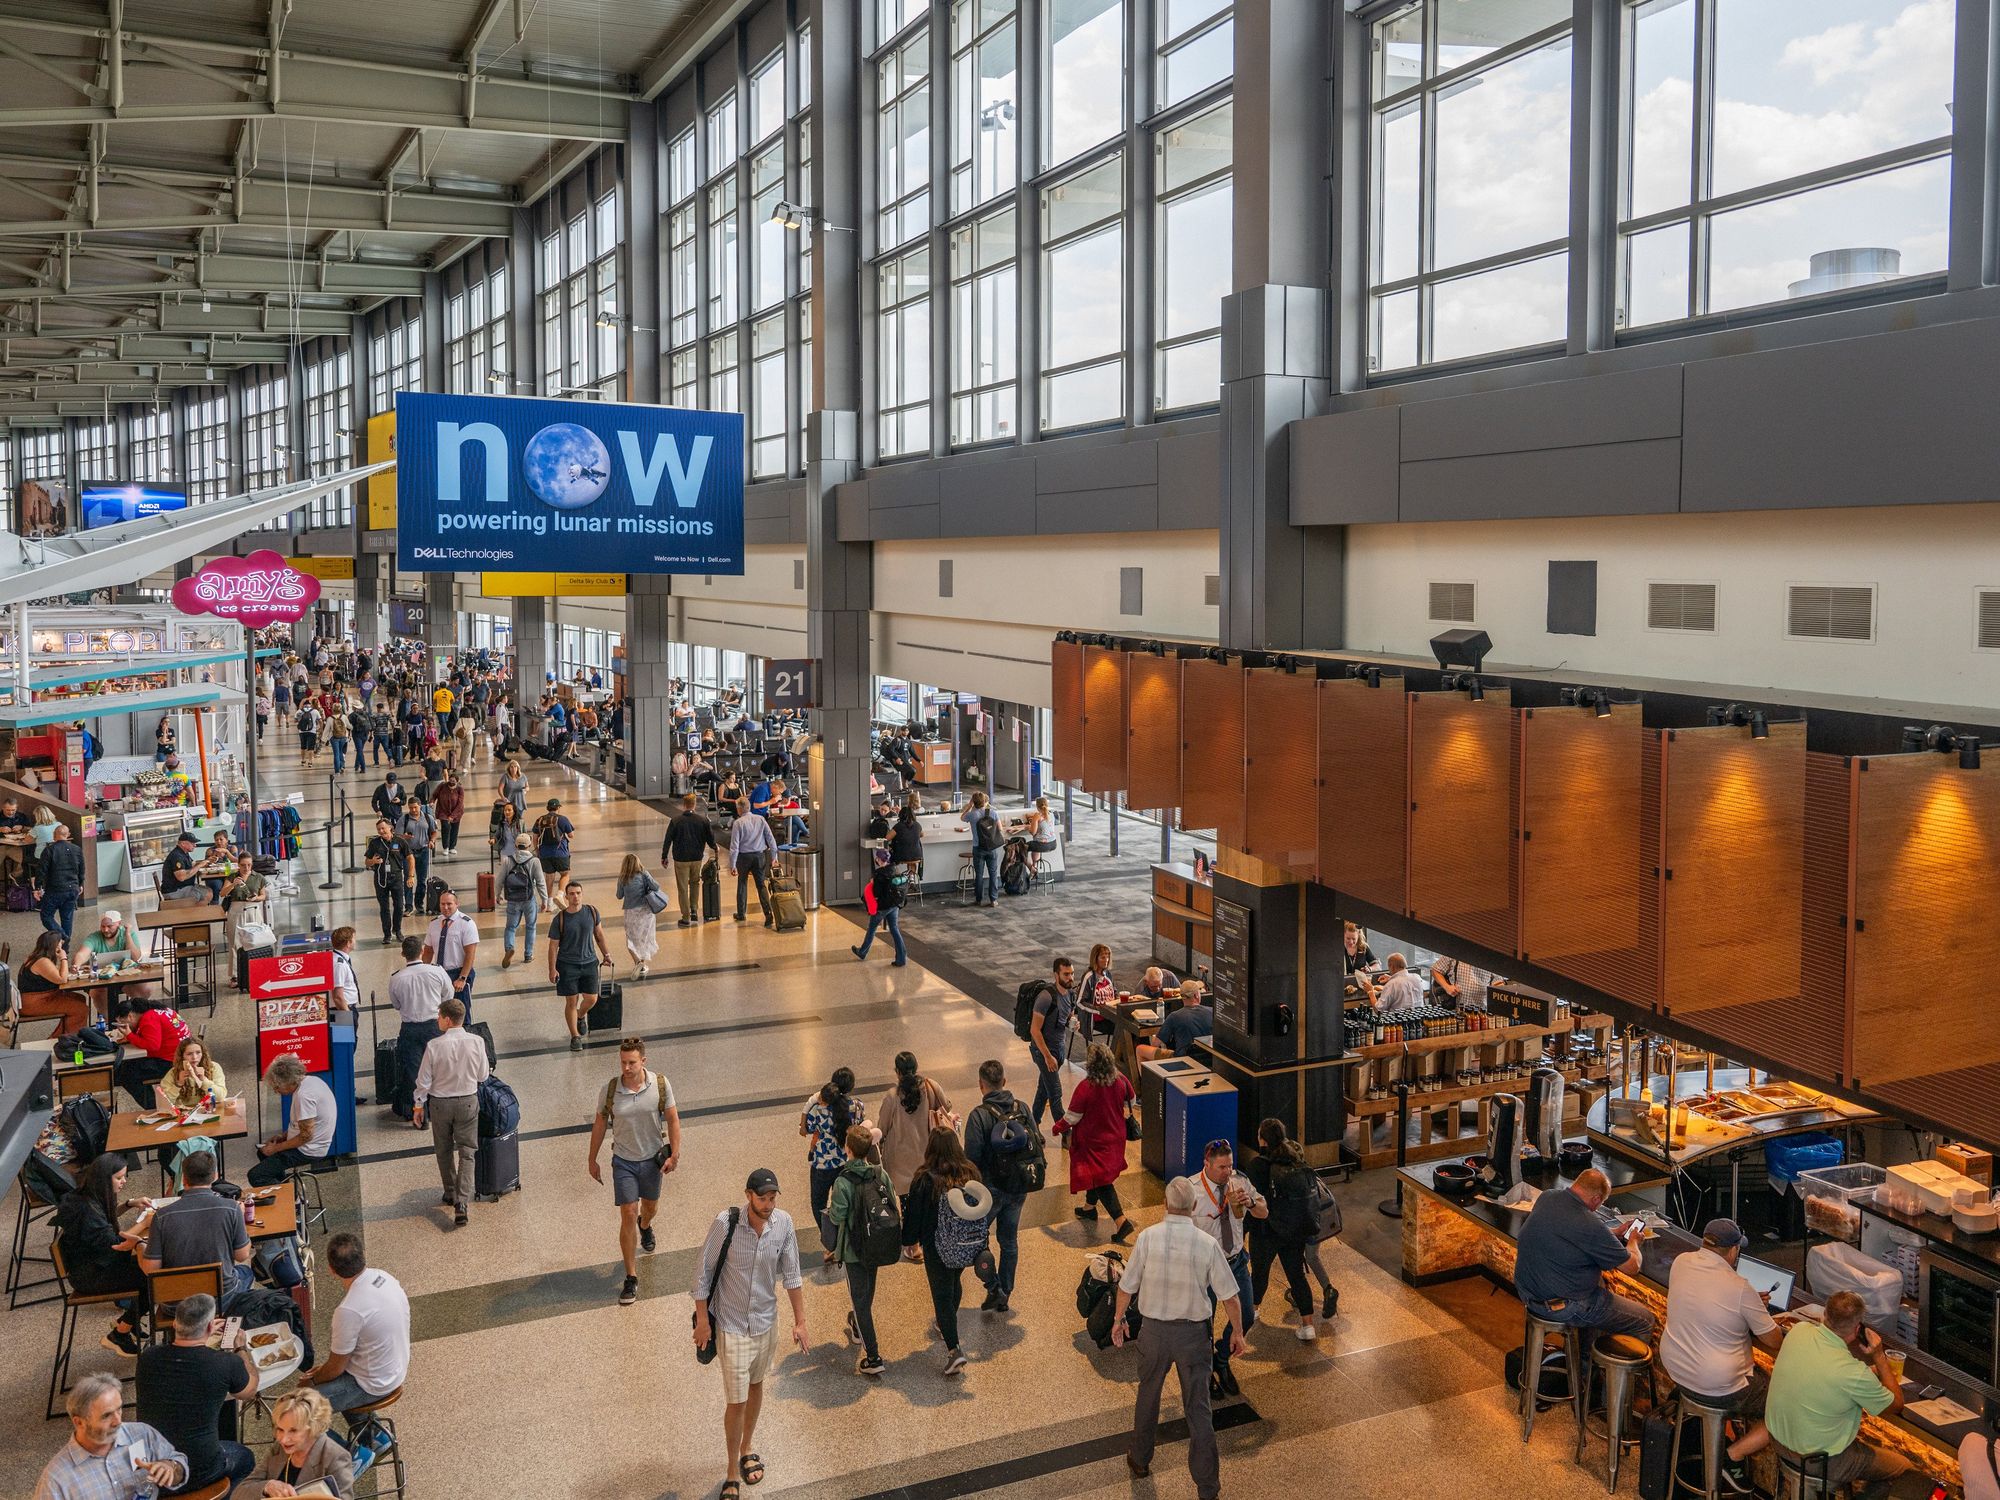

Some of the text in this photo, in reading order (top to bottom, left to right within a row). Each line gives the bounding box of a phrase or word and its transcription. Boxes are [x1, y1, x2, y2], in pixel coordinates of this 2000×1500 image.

[438, 511, 714, 536] powering lunar missions
[242, 604, 300, 613] creams
[408, 608, 424, 620] 20
[65, 631, 195, 655] PEOPLE
[775, 671, 805, 697] 21
[266, 997, 319, 1017] PIZZA
[1492, 991, 1542, 1011] PICK UP HERE
[272, 1037, 301, 1046] Pepperoni
[286, 1043, 303, 1051] $7.00
